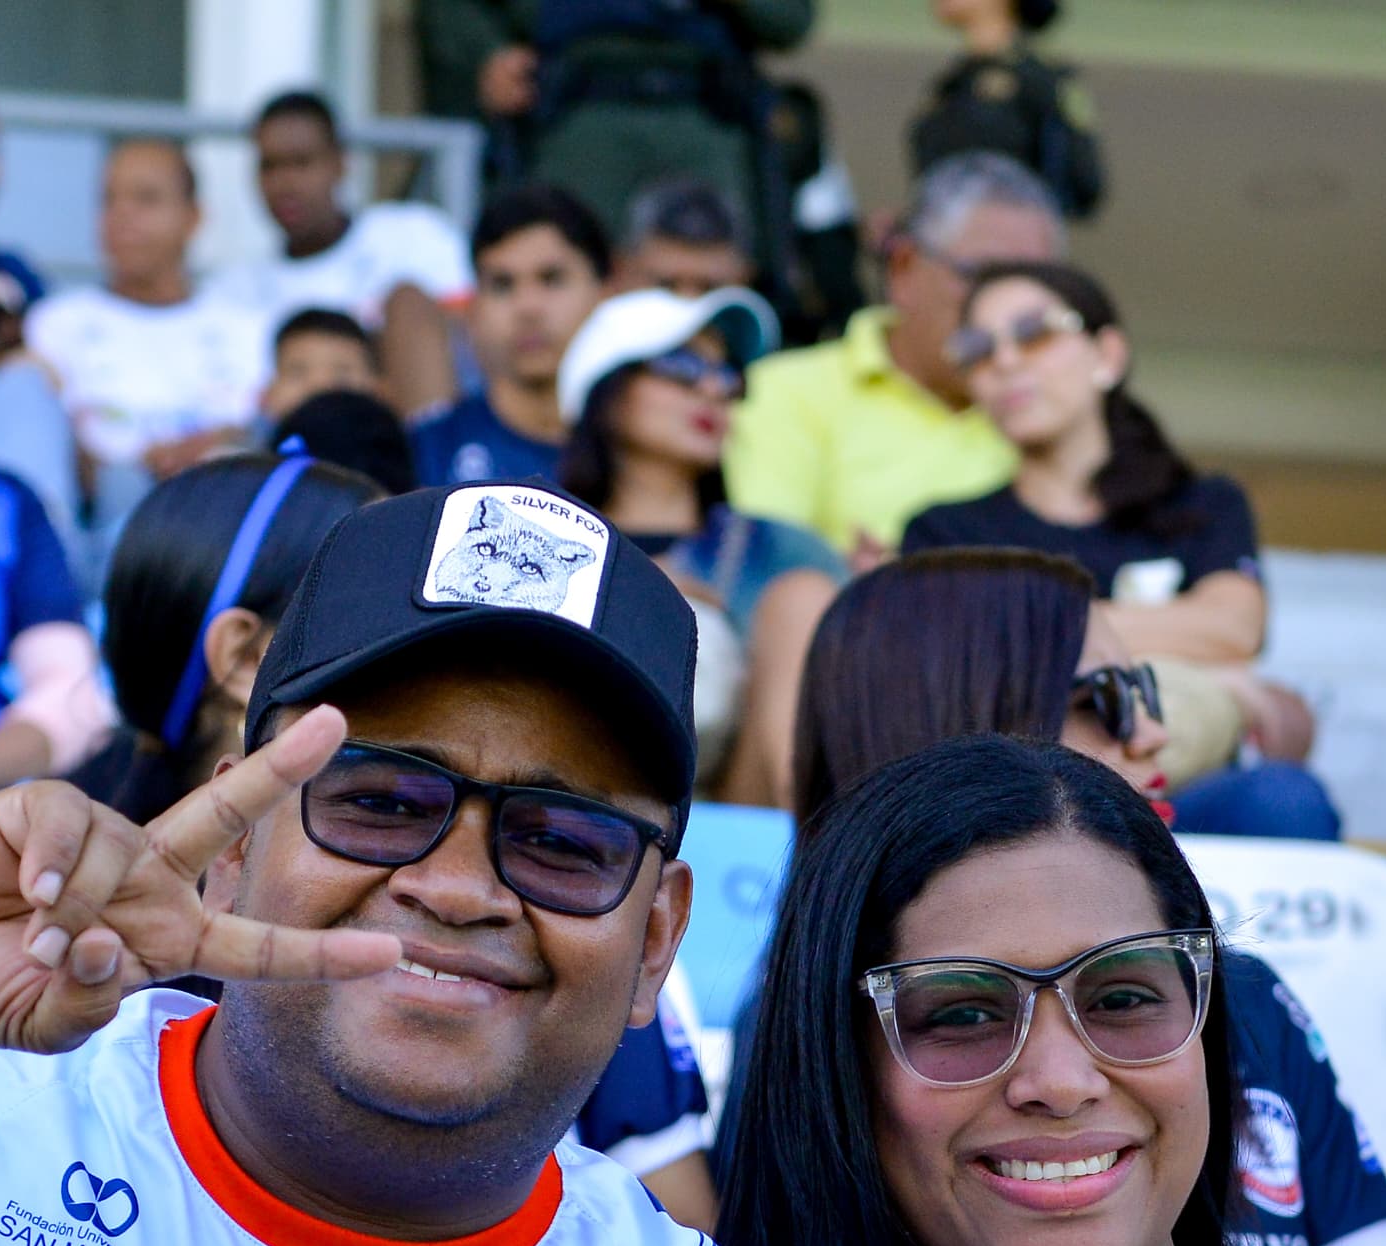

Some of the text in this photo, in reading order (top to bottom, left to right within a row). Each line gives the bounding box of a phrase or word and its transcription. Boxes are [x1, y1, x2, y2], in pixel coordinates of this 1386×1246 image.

[511, 494, 606, 539] SILVER FOX
[6, 1200, 74, 1237] Fundación
